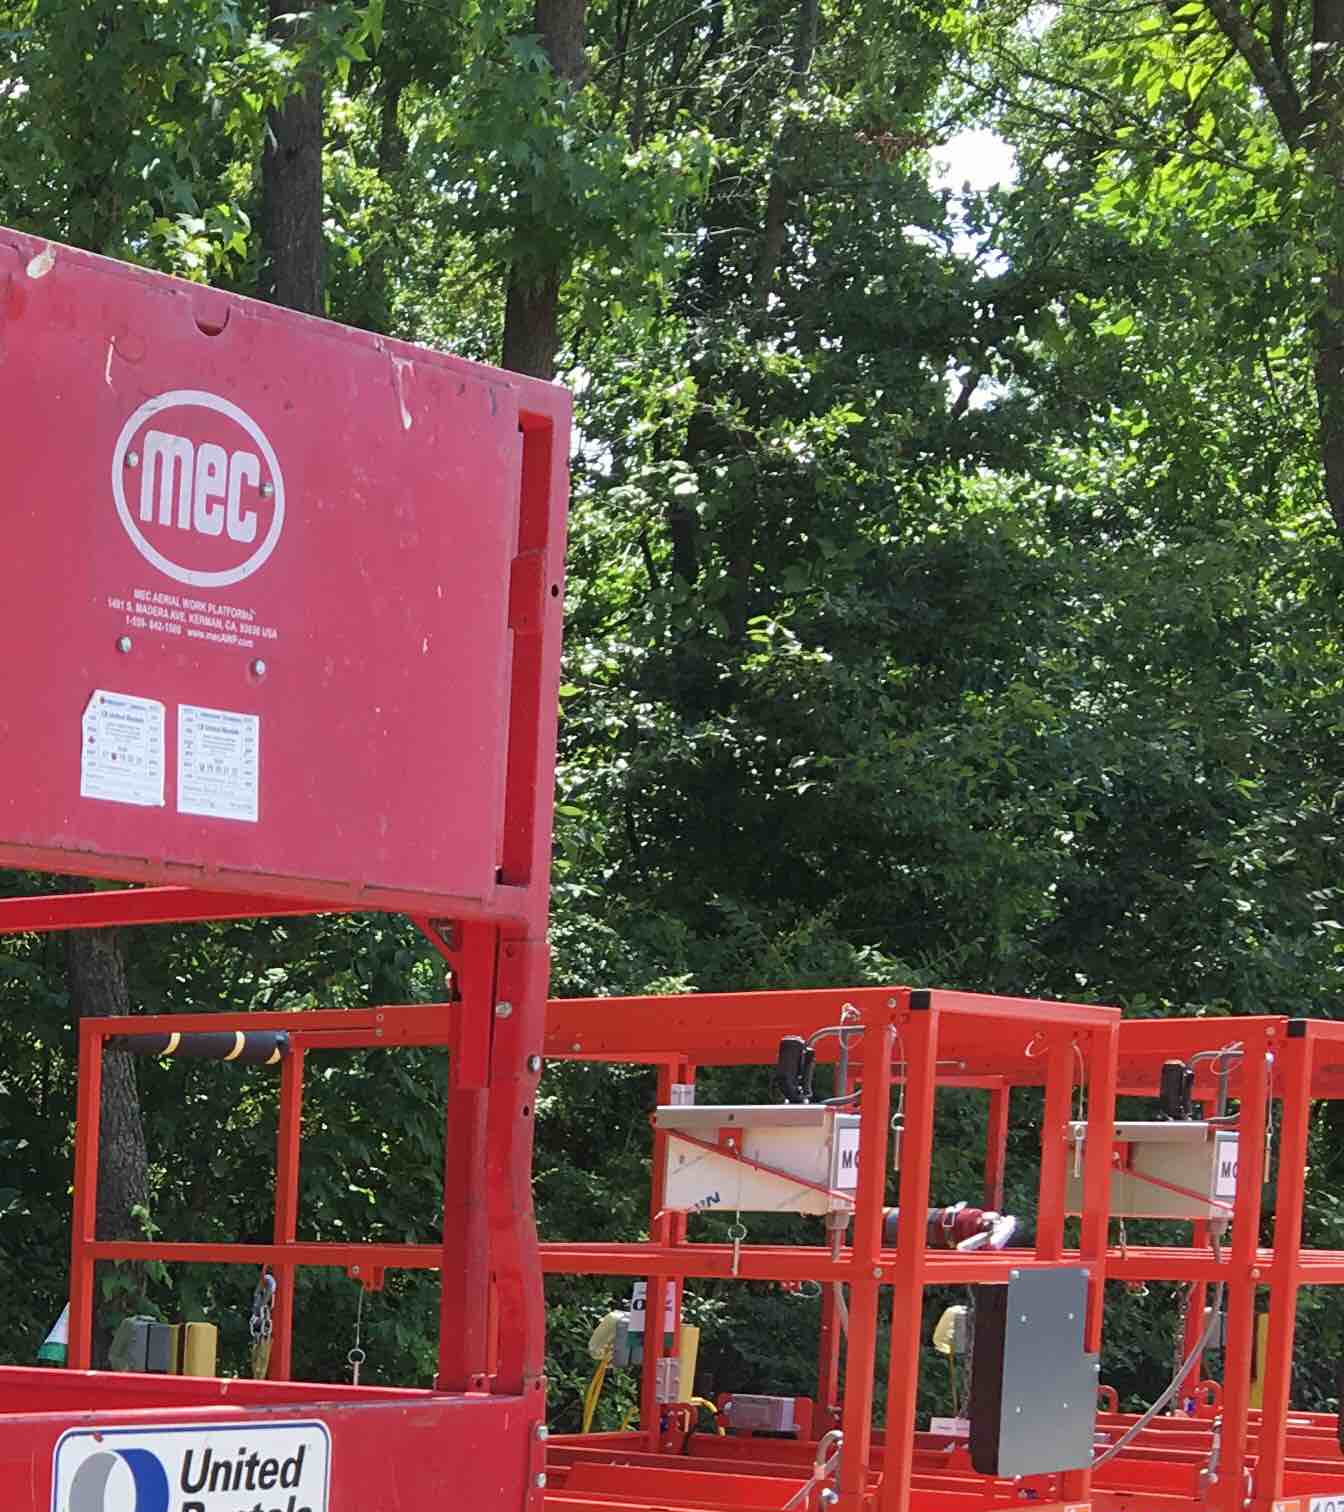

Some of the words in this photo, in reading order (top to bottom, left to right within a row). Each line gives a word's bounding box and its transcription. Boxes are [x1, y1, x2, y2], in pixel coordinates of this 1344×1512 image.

[140, 430, 260, 543] mec
[134, 589, 151, 601] MEC
[152, 592, 180, 608] AERIAL
[182, 598, 206, 611] WORK
[262, 627, 278, 640] USA
[180, 1444, 306, 1494] United
